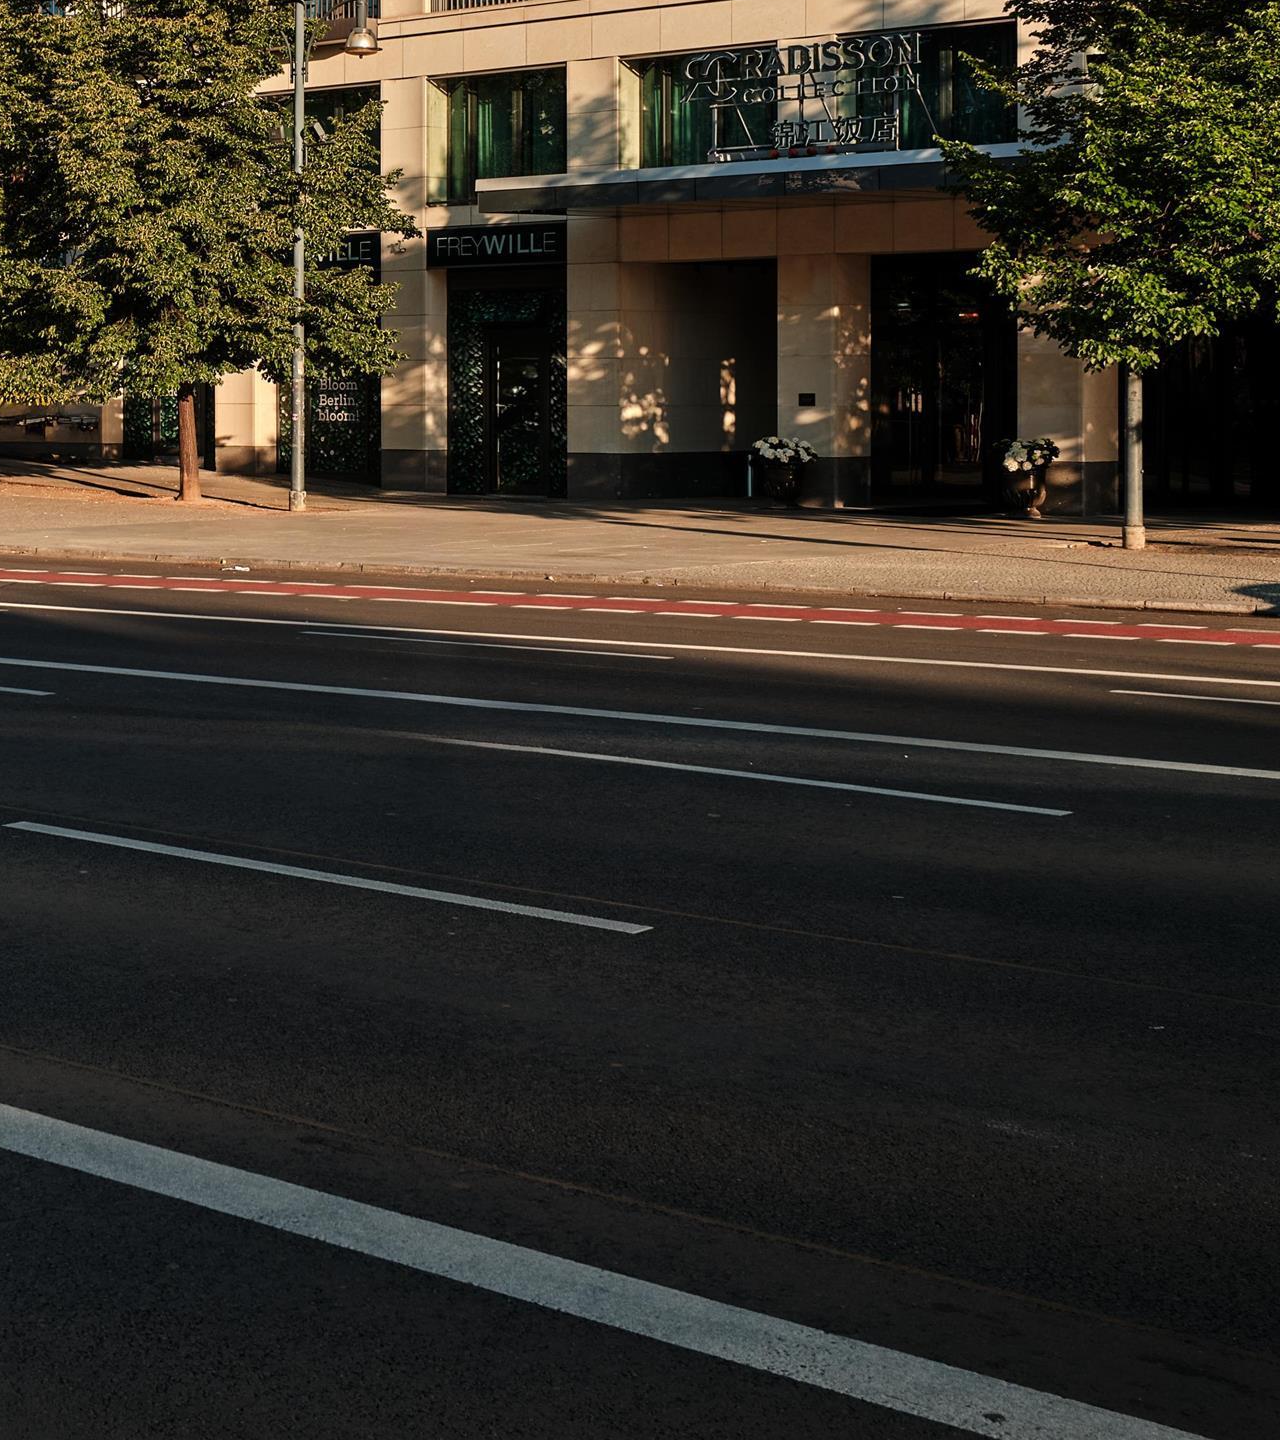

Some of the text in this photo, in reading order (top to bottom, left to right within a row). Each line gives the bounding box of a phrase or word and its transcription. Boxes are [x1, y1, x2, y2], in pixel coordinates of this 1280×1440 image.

[741, 32, 922, 80] RADISSON
[743, 73, 921, 105] COLLECTION
[436, 231, 556, 257] FREYWILLE
[319, 378, 359, 391] Bloom
